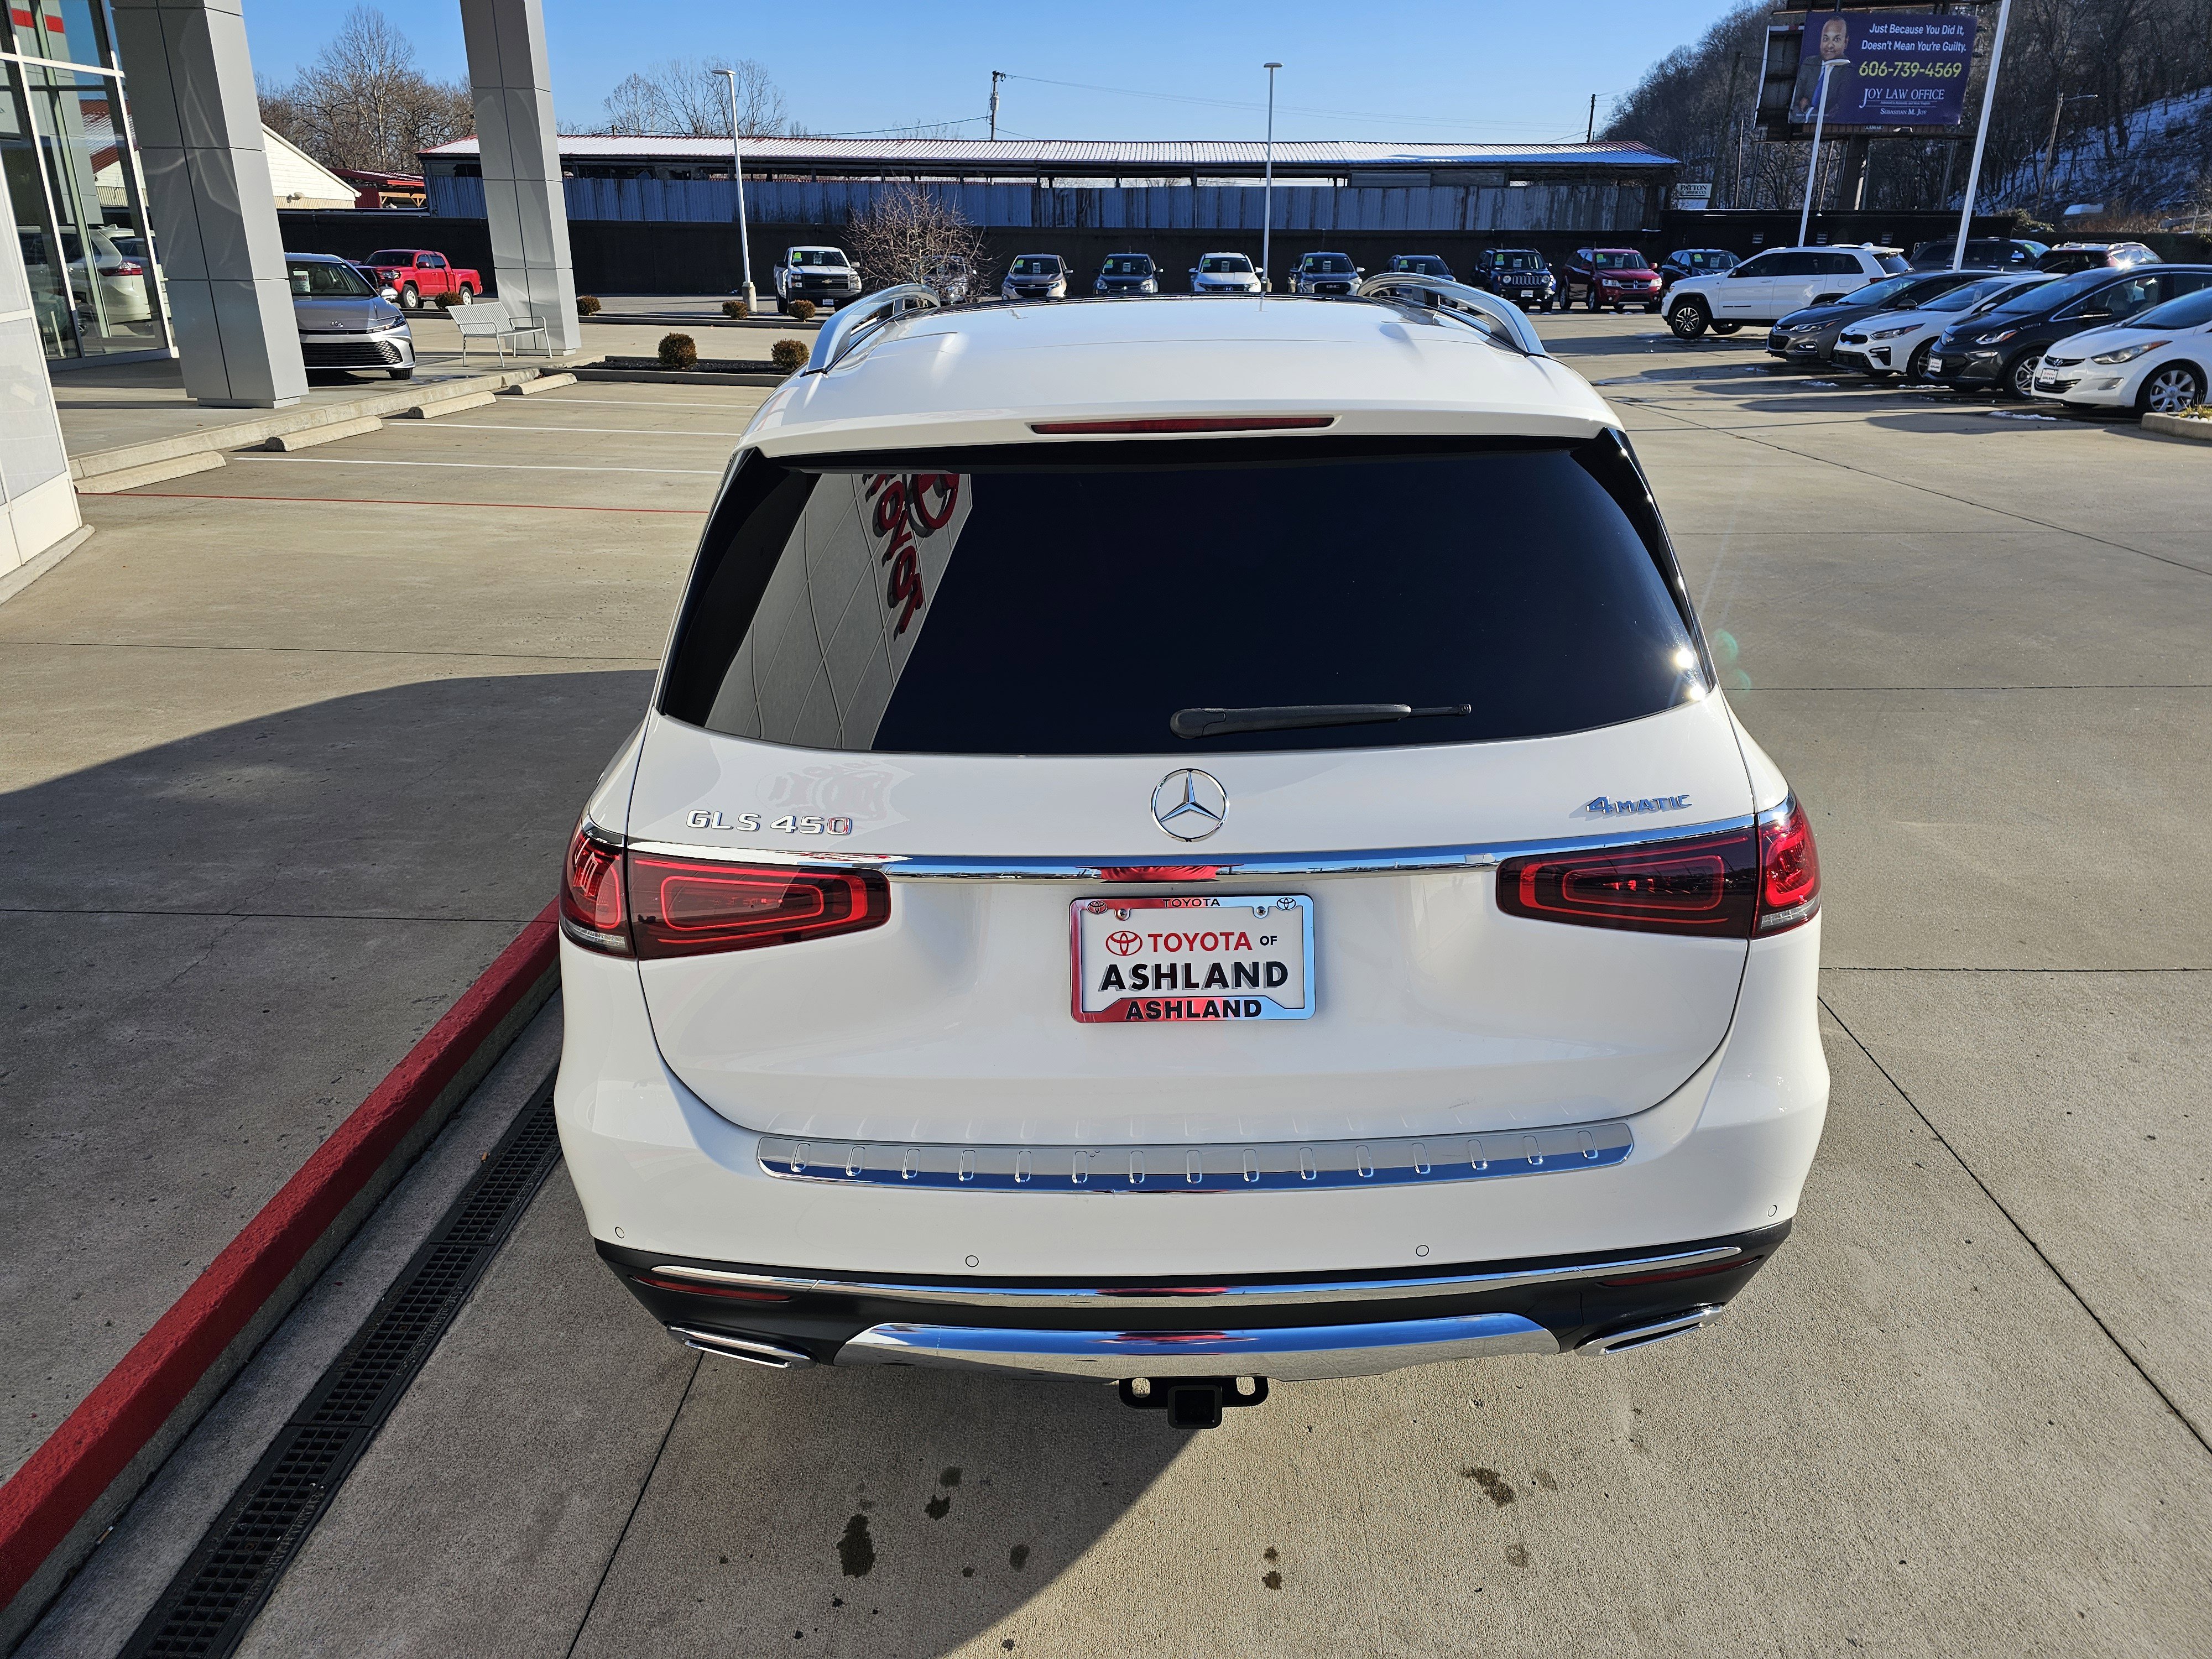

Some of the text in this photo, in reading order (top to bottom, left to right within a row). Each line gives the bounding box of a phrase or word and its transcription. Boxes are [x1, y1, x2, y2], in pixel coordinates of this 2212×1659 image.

[1869, 23, 1965, 36] Just Because You Did It,
[1861, 40, 1966, 53] Doesn't Mean You're Guilty.
[1859, 61, 1962, 77] 606-739-4569
[1859, 88, 1883, 109] JOY
[1886, 89, 1908, 100] LAW
[1911, 89, 1945, 100] OFFICE
[1586, 795, 1693, 815] 4MATIC
[686, 809, 853, 836] GLS 450
[1162, 898, 1220, 908] TOYOTA
[1147, 931, 1277, 952] TOYOTA OF
[1098, 961, 1288, 992] ASHLAND
[1126, 999, 1262, 1020] ASHLAND
